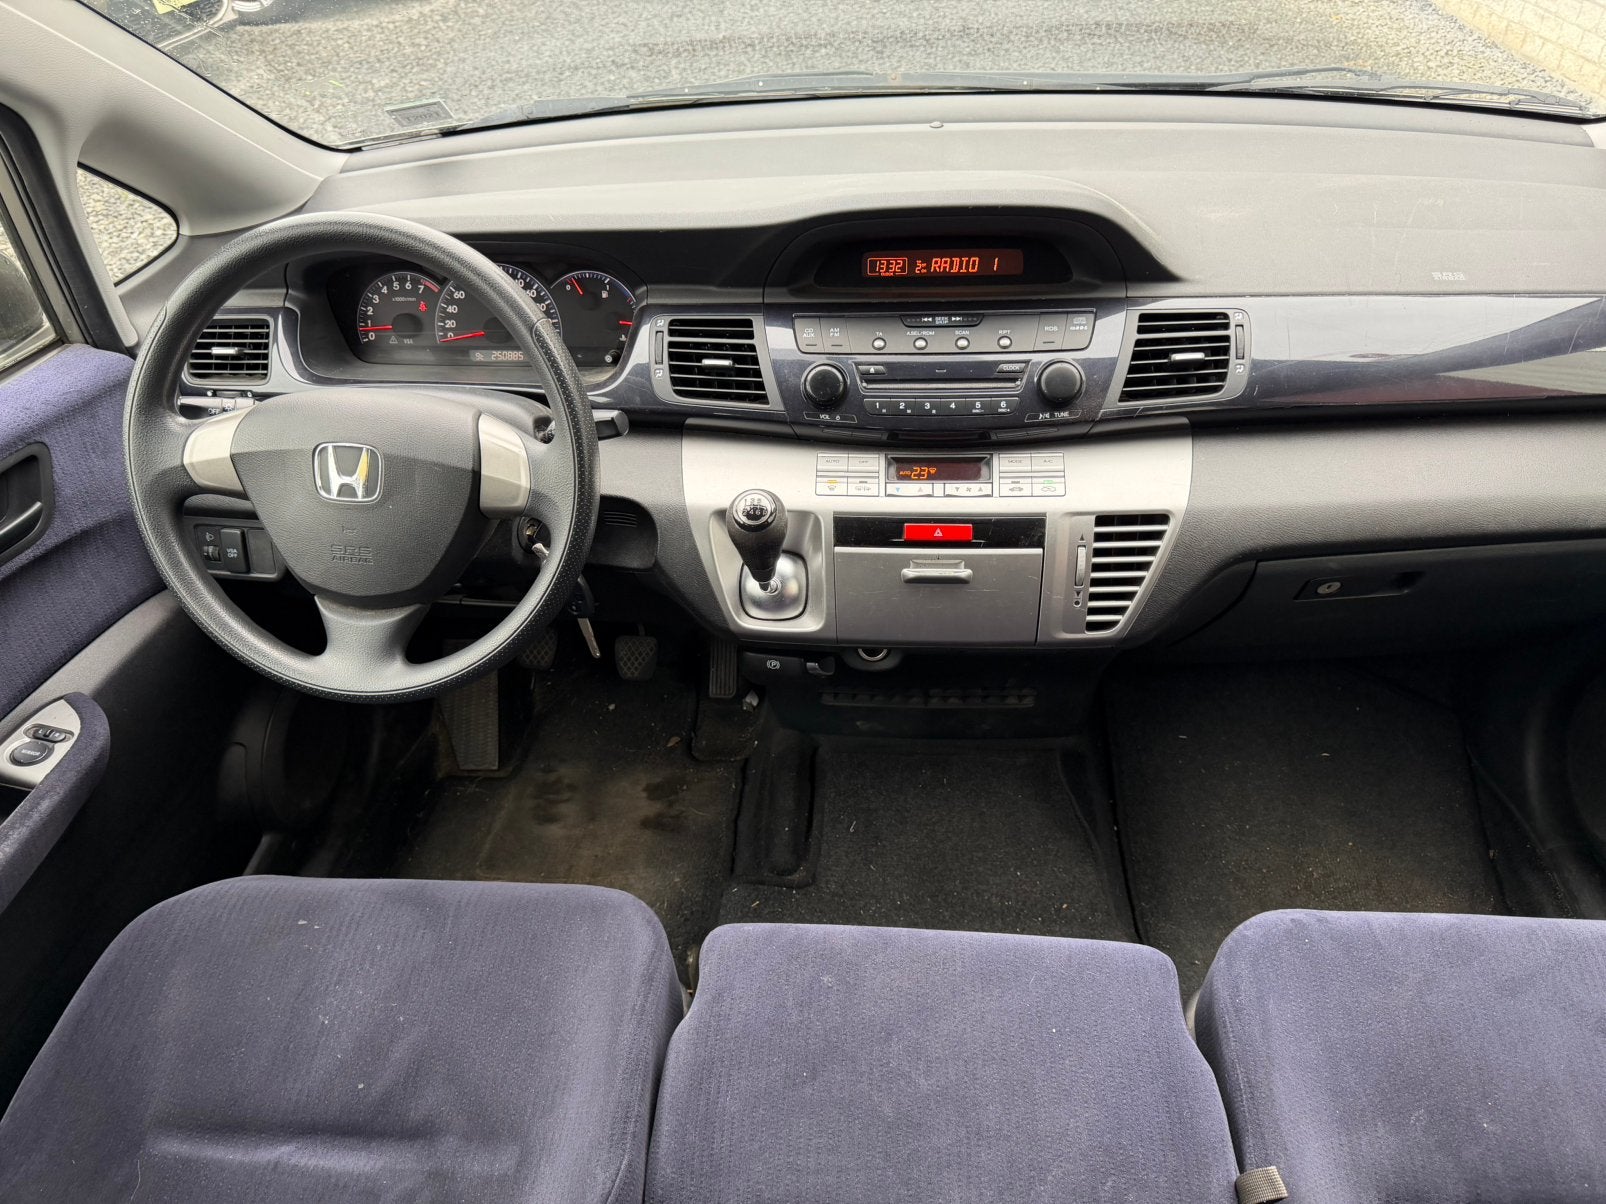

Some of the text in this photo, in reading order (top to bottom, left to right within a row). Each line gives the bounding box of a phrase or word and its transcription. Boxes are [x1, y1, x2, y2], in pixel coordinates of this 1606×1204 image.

[931, 257, 979, 273] RADIO
[381, 286, 388, 294] 4
[393, 282, 399, 290] 5
[418, 285, 424, 293] 7
[372, 295, 379, 303] 3
[454, 291, 465, 299] 60
[367, 307, 373, 315] 2
[446, 305, 458, 313] 40
[491, 351, 524, 360] 250885
[911, 467, 928, 478] 23
